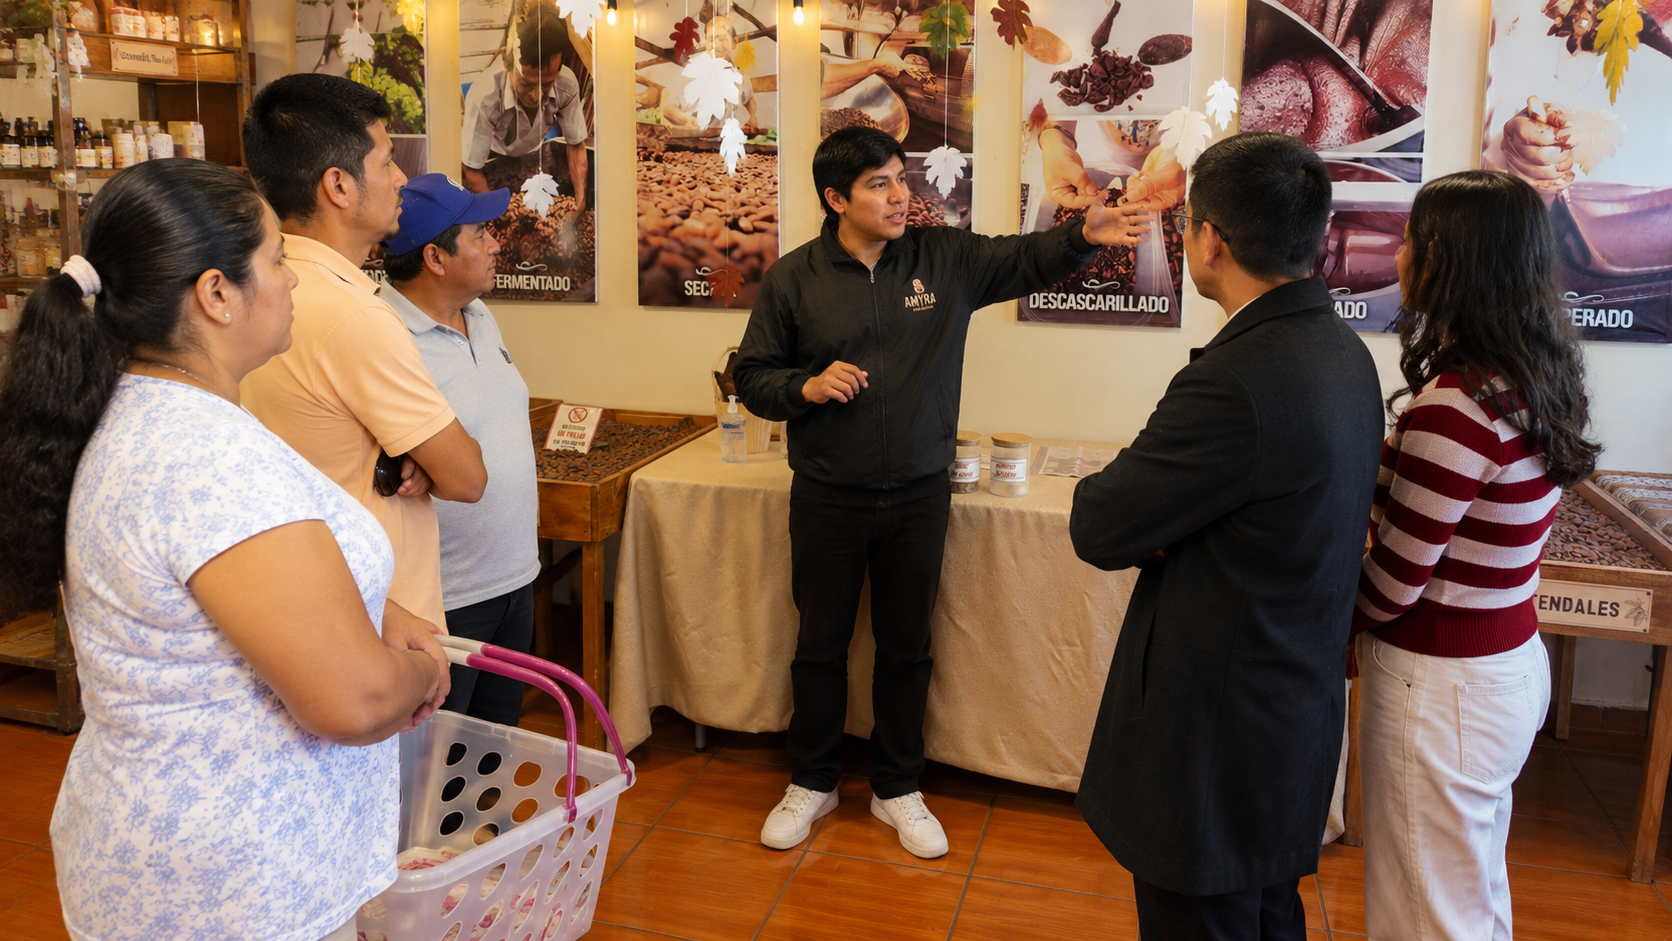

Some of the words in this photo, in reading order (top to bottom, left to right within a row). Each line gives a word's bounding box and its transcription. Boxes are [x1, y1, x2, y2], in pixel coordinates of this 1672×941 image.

[905, 292, 936, 308] AMYRA
[1029, 293, 1170, 313] DESCASCARILLADO
[1332, 301, 1367, 319] ADO
[1534, 594, 1620, 617] ENDALES
